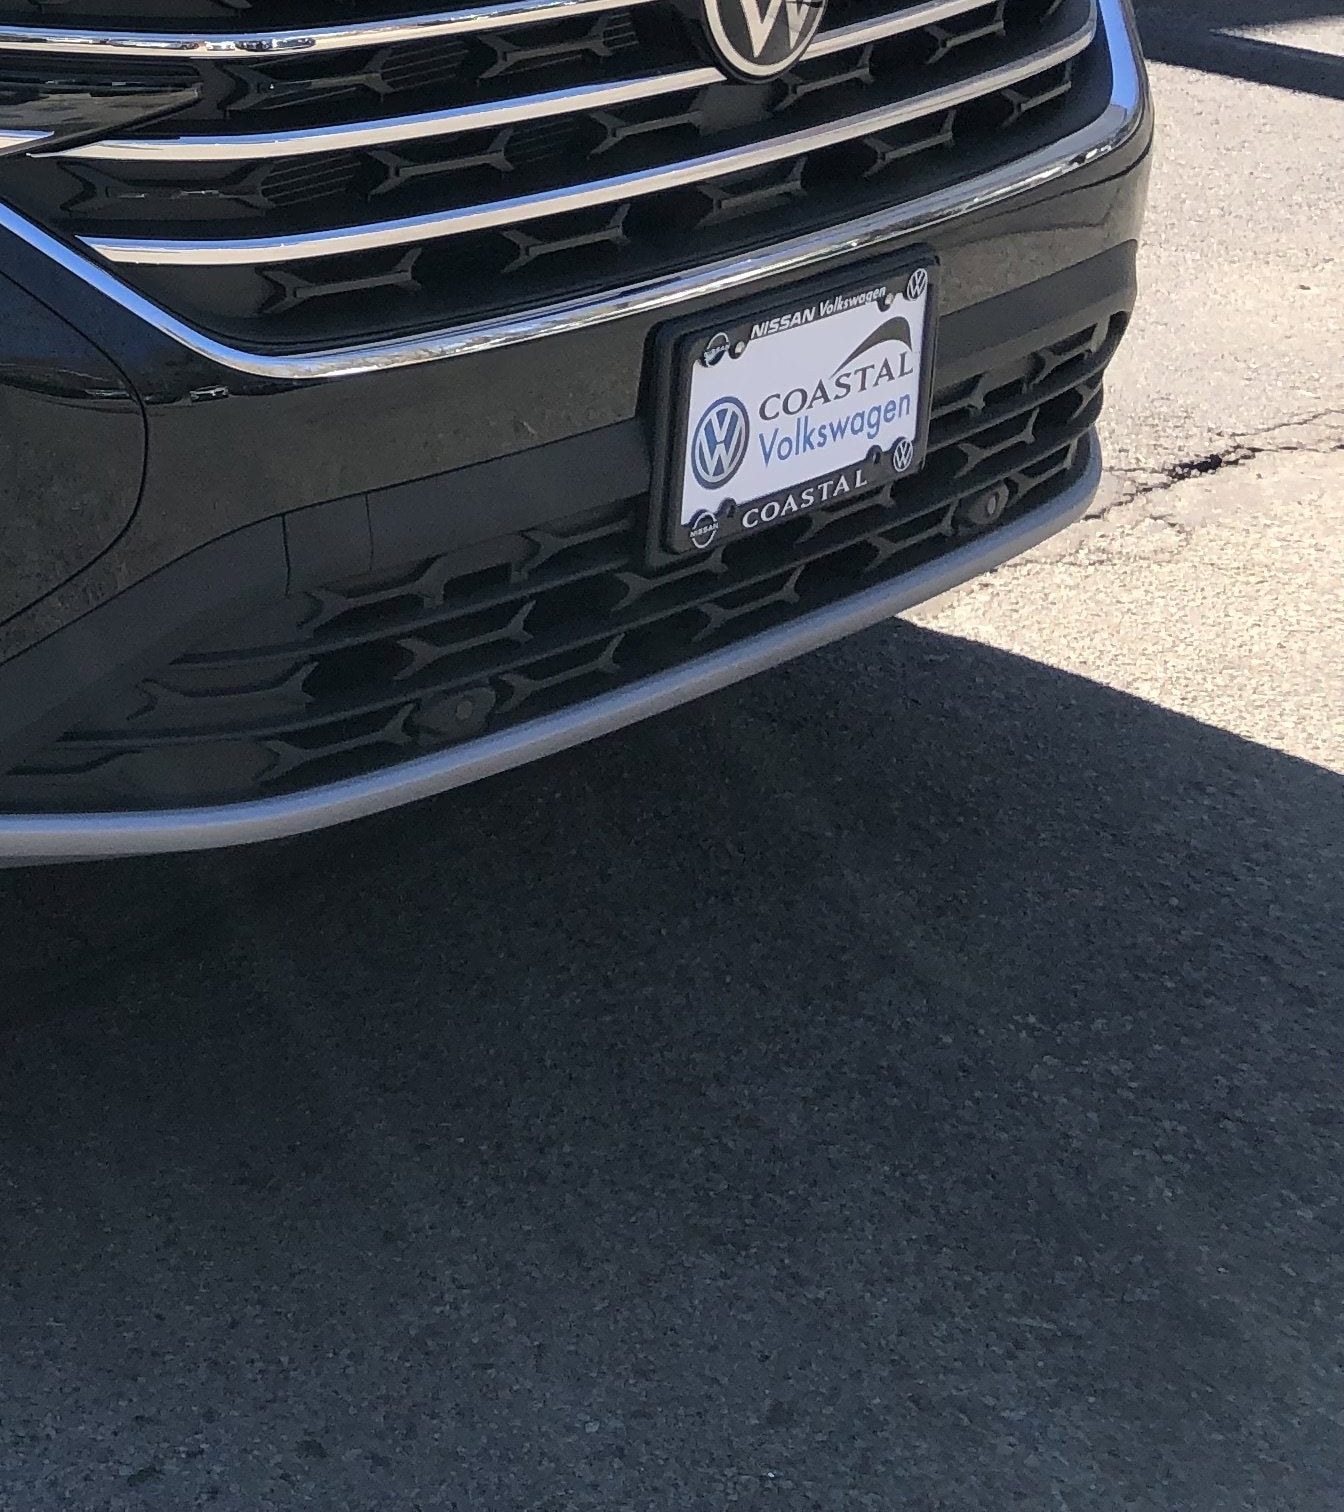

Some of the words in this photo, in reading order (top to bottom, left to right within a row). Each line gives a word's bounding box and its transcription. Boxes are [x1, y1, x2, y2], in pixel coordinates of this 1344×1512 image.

[750, 307, 816, 339] NISSAN
[819, 286, 886, 317] Volkswagen
[758, 351, 914, 421] COASTAL
[758, 393, 911, 467] Volkswagen
[741, 469, 868, 529] COASTAL
